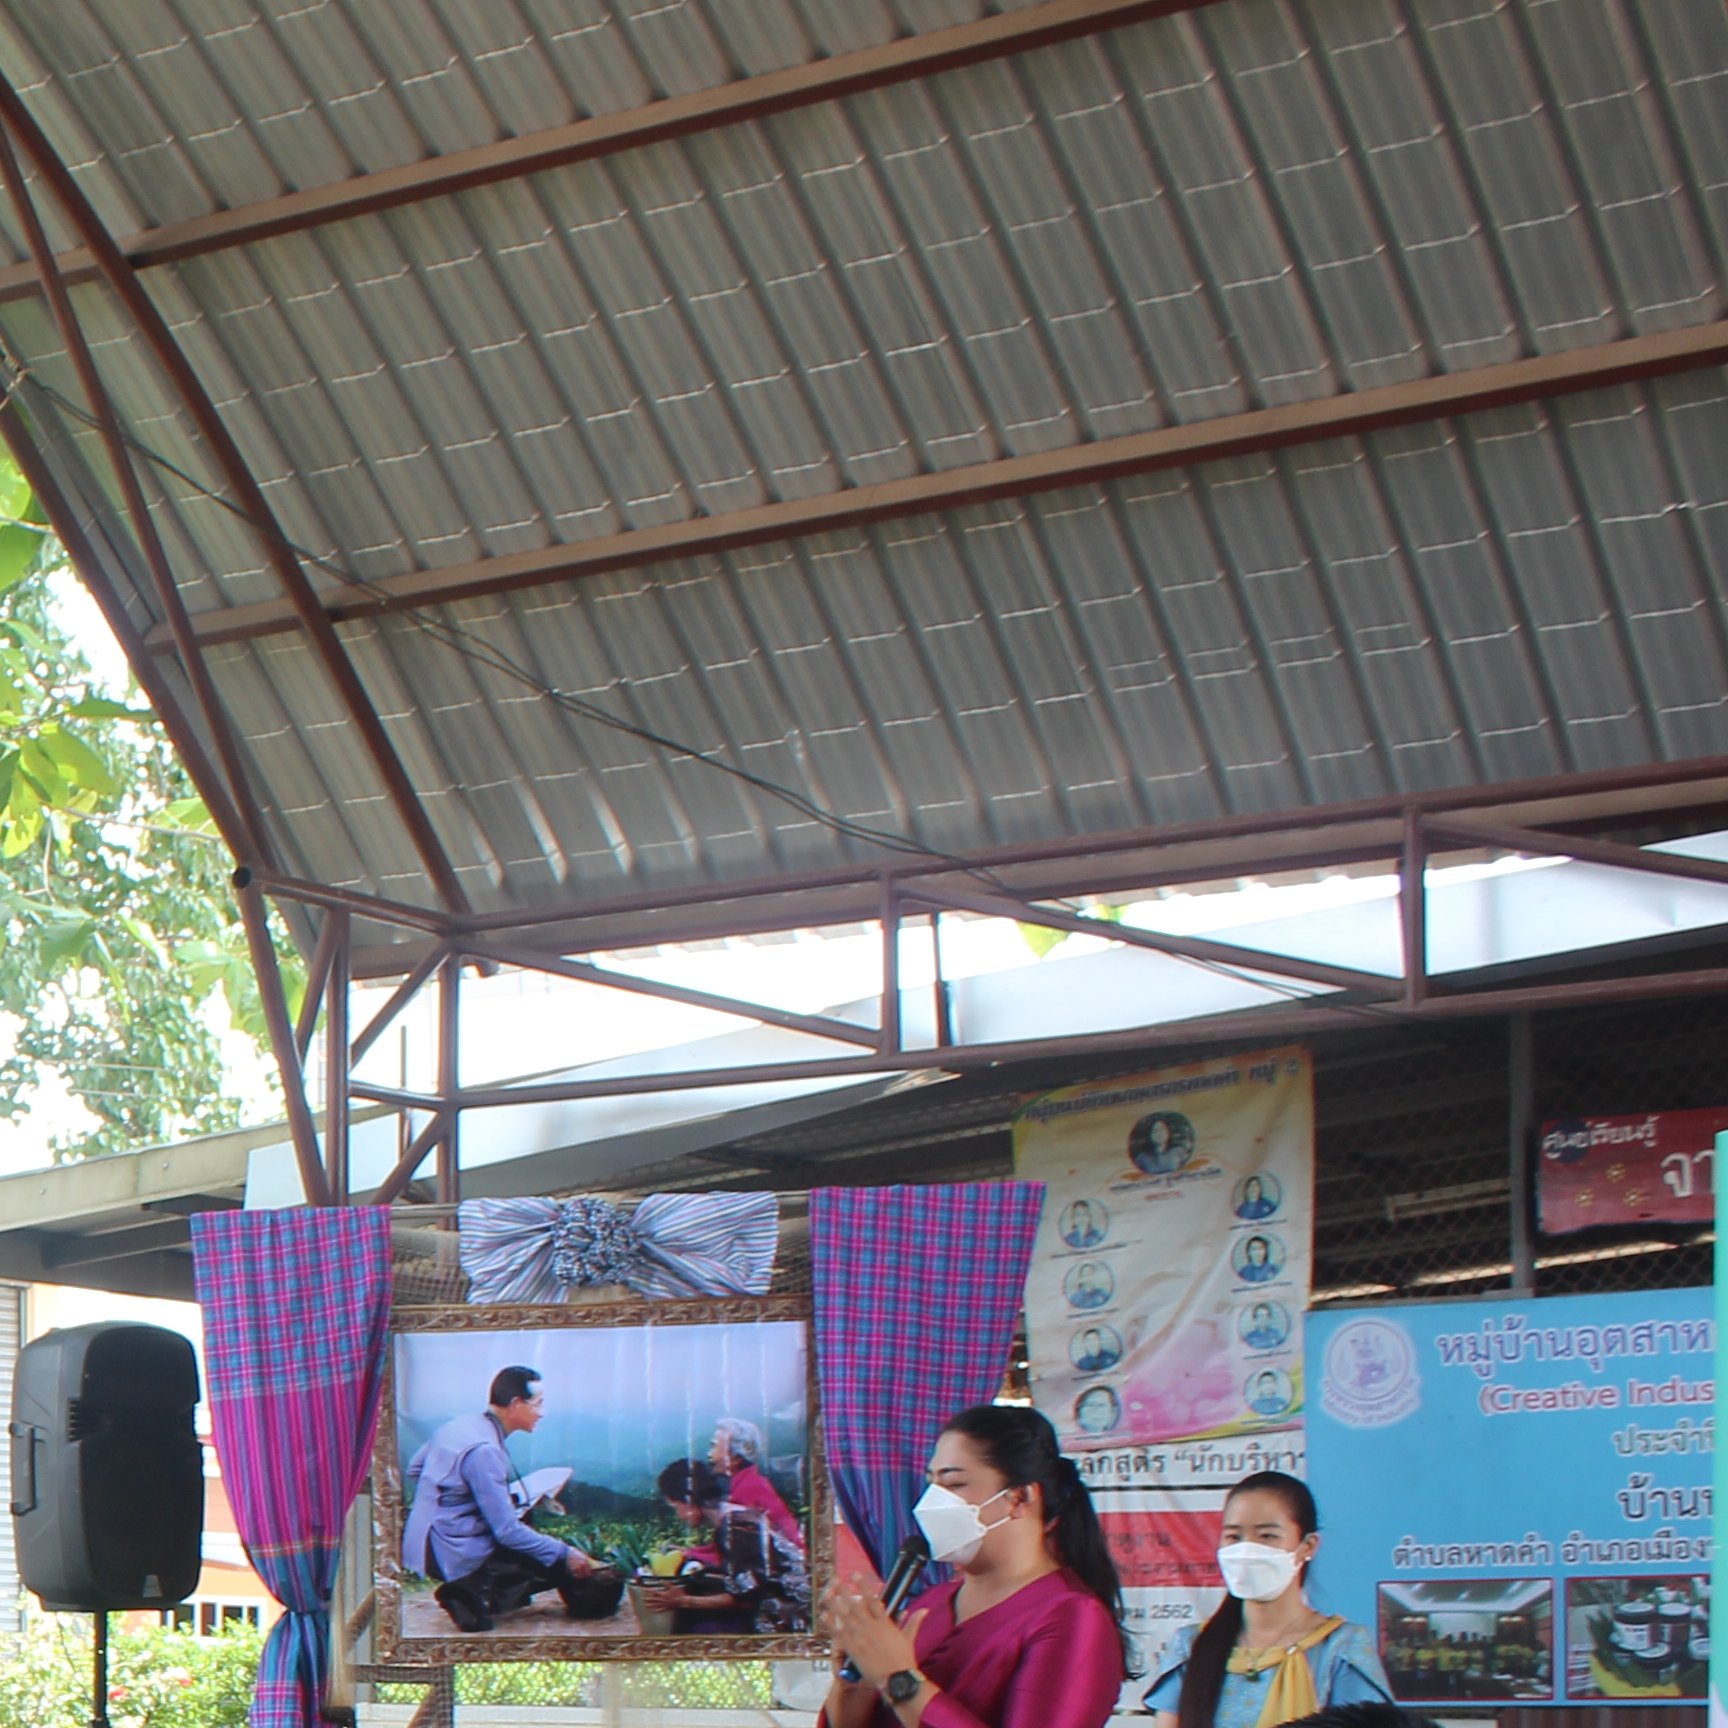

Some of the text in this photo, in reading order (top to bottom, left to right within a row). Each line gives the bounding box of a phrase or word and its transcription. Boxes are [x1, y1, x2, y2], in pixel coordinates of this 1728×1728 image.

[1479, 1376, 1715, 1416] (Creative Indus
[1560, 1527, 1713, 1563] อำเภอเมือง
[1151, 1604, 1193, 1619] 2562
